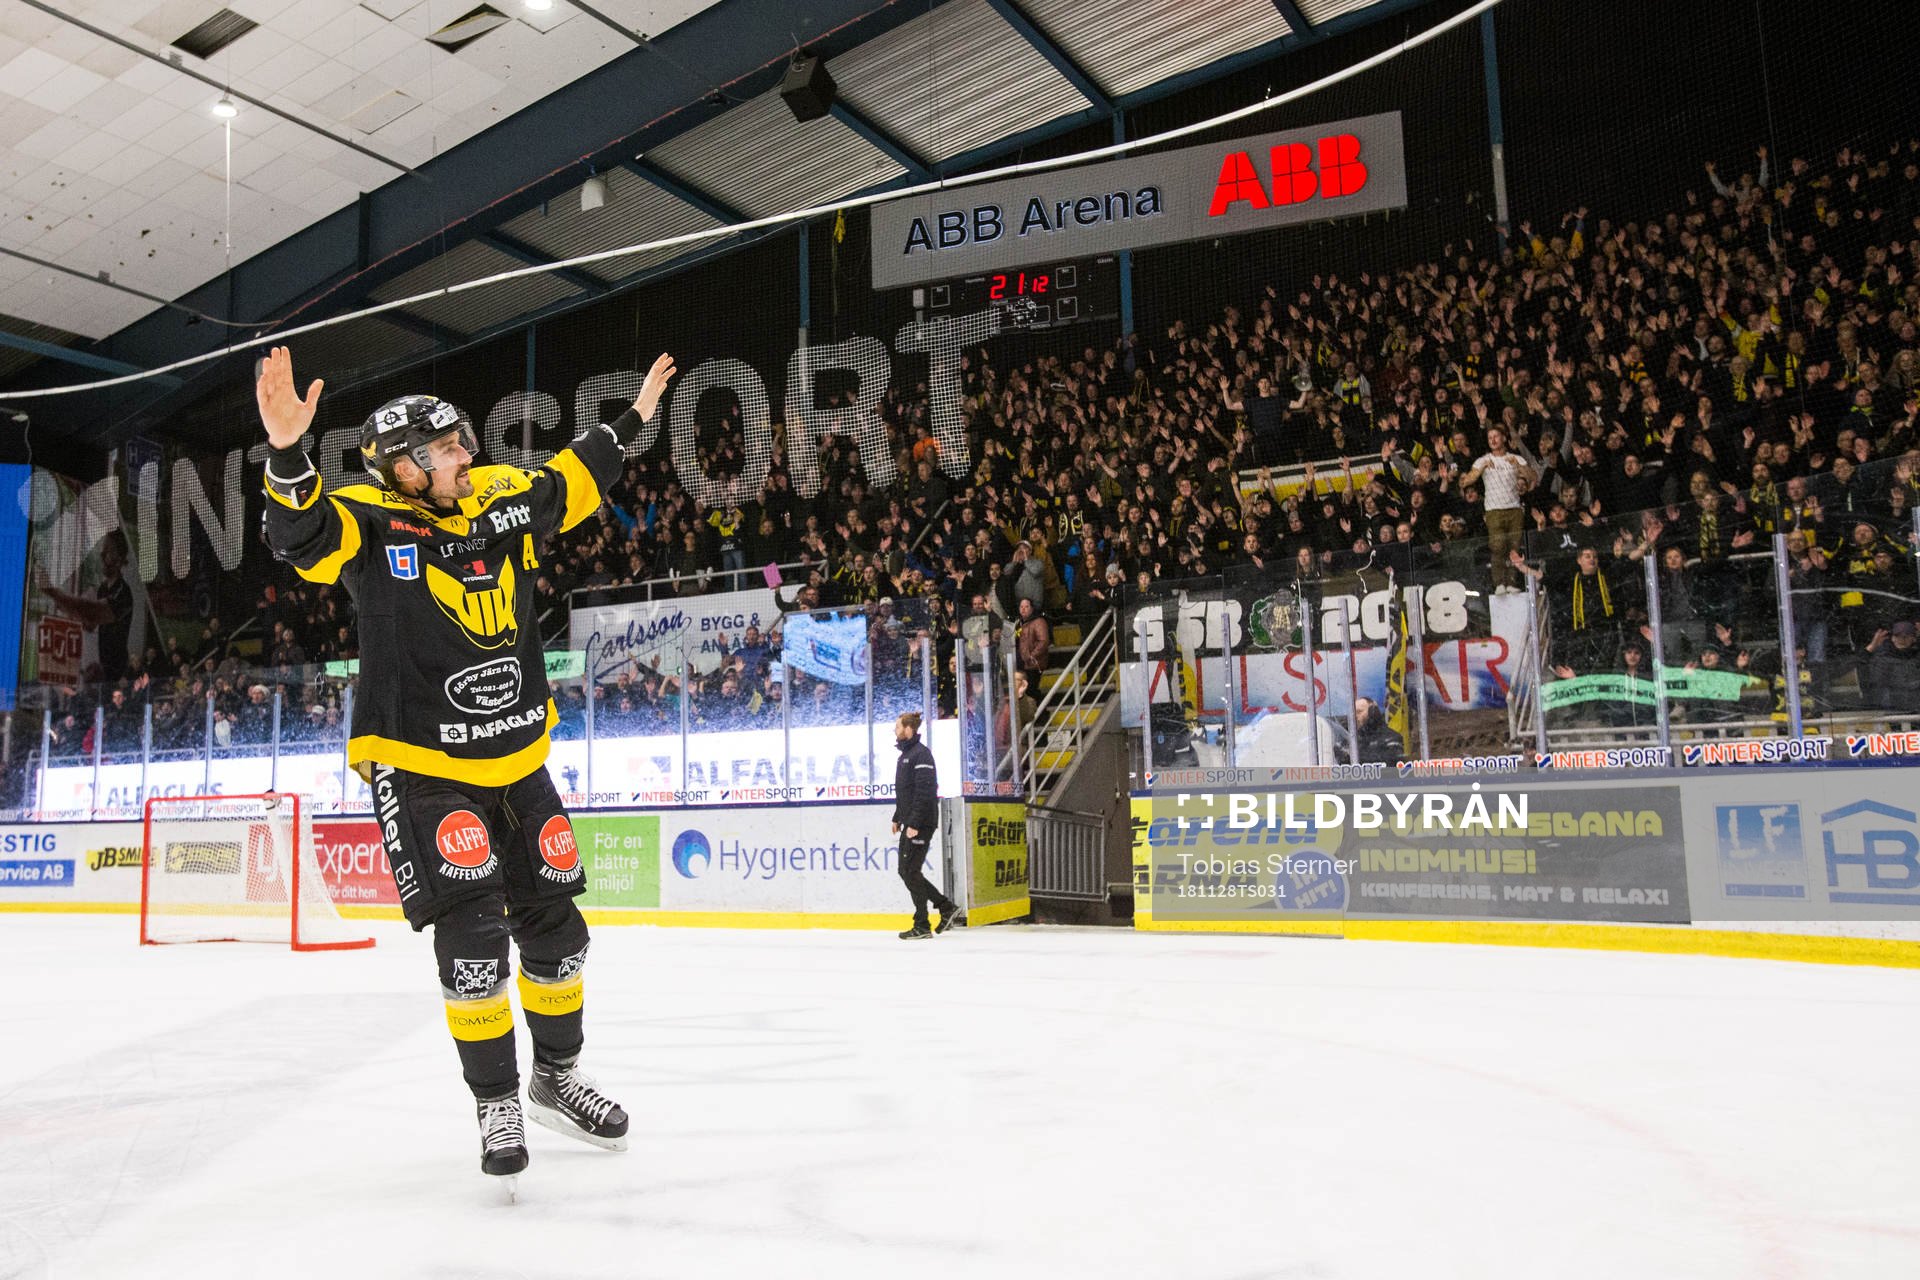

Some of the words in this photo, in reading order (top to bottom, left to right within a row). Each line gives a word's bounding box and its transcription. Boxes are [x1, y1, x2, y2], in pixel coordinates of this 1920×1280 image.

[1208, 133, 1368, 217] ABB
[903, 204, 1004, 256] ABB
[1017, 185, 1162, 237] Arena
[384, 442, 408, 454] CCM
[389, 519, 433, 537] MARK
[439, 542, 455, 558] LF
[456, 538, 487, 554] INVEST
[522, 533, 540, 571] A
[701, 614, 745, 631] BYGG
[586, 610, 692, 672] Carlsson
[1553, 747, 1669, 768] INTERSPORT
[1702, 738, 1829, 764] INTERSPORT
[688, 753, 881, 789] ALFAGLAS
[1160, 768, 1256, 785] INTERSPORT
[1284, 762, 1383, 782] INTERSPORT
[1413, 756, 1522, 777] INTERSPORT
[560, 791, 622, 804] NTERSPORT
[641, 790, 710, 803] INTERSPORT
[730, 786, 804, 801] INTERSPORT
[98, 808, 142, 820] INTERSPOR
[0, 834, 57, 852] STIG
[441, 826, 487, 855] KAFFE
[543, 830, 576, 857] KAFFE
[594, 832, 618, 849] För
[623, 837, 643, 849] en
[594, 854, 640, 871] bättre
[719, 836, 934, 880] Hygientekn
[1359, 848, 1537, 875] INOMHUS!
[43, 863, 65, 880] AB
[395, 860, 420, 901] Bil
[594, 875, 635, 894] miljö!
[1360, 881, 1498, 901] KONFERENS,
[1504, 885, 1554, 904] MAT
[1559, 887, 1576, 904] &
[1582, 887, 1670, 905] RELAX!
